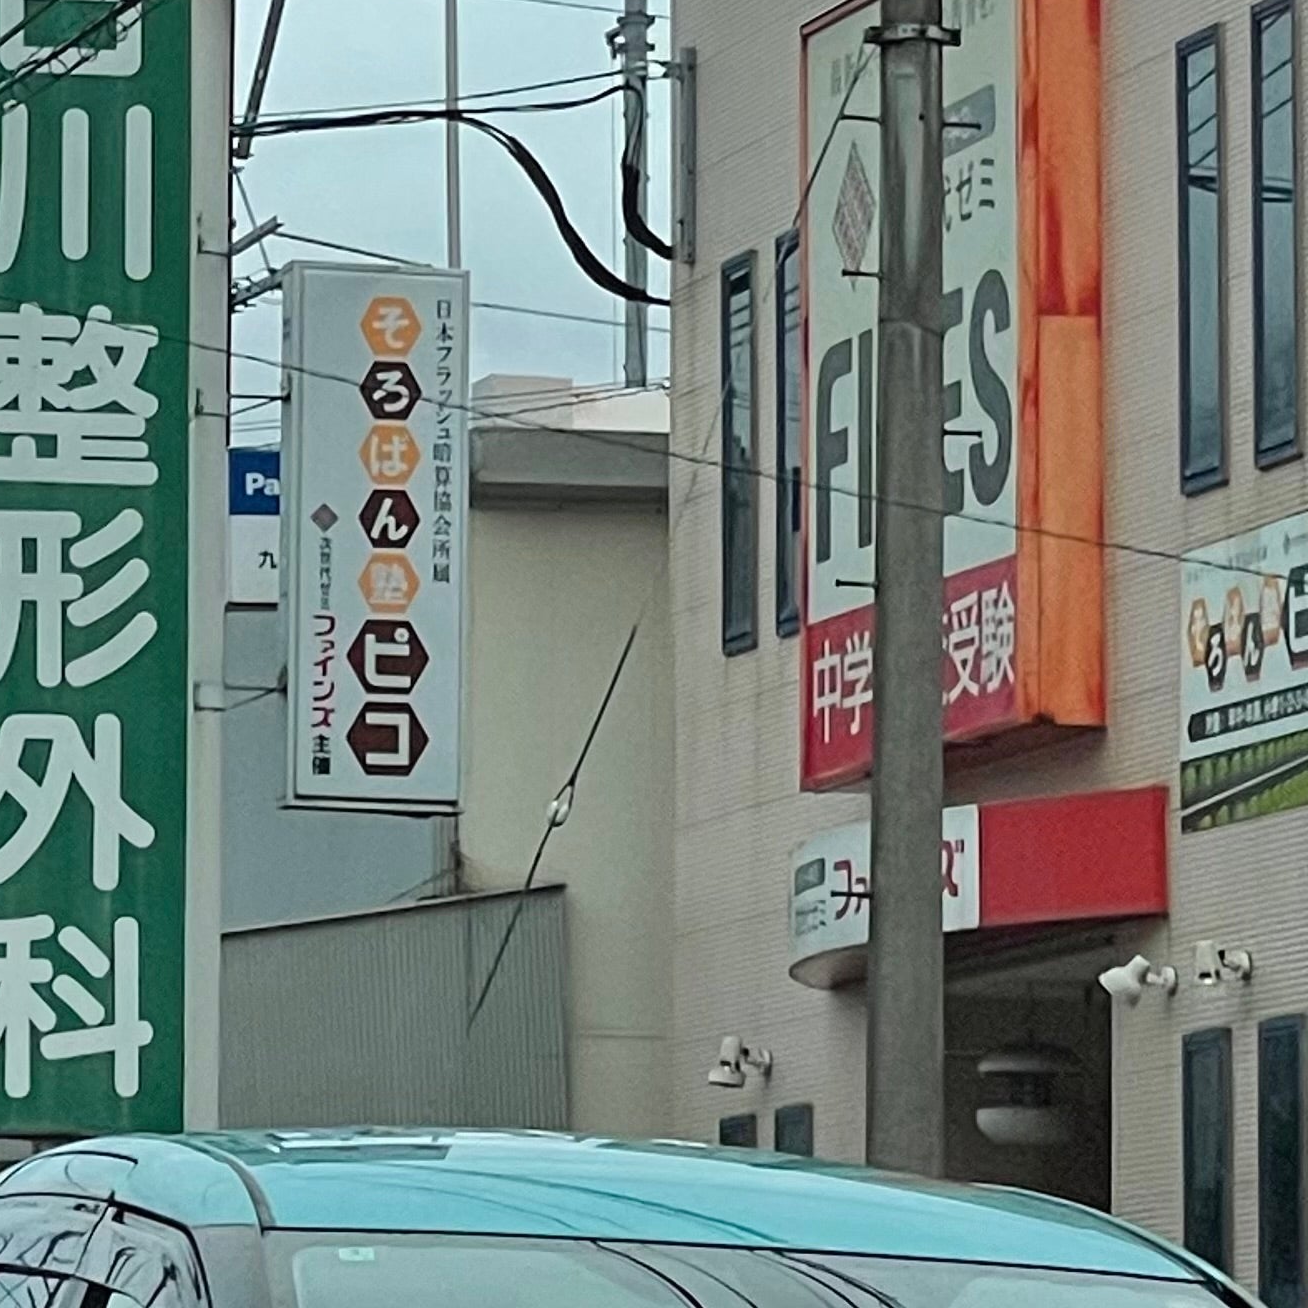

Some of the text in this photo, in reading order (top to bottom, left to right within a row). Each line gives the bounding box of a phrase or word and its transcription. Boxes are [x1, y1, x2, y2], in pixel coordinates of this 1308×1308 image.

[816, 268, 1013, 565] FIES
[812, 580, 1015, 745] 中学受験
